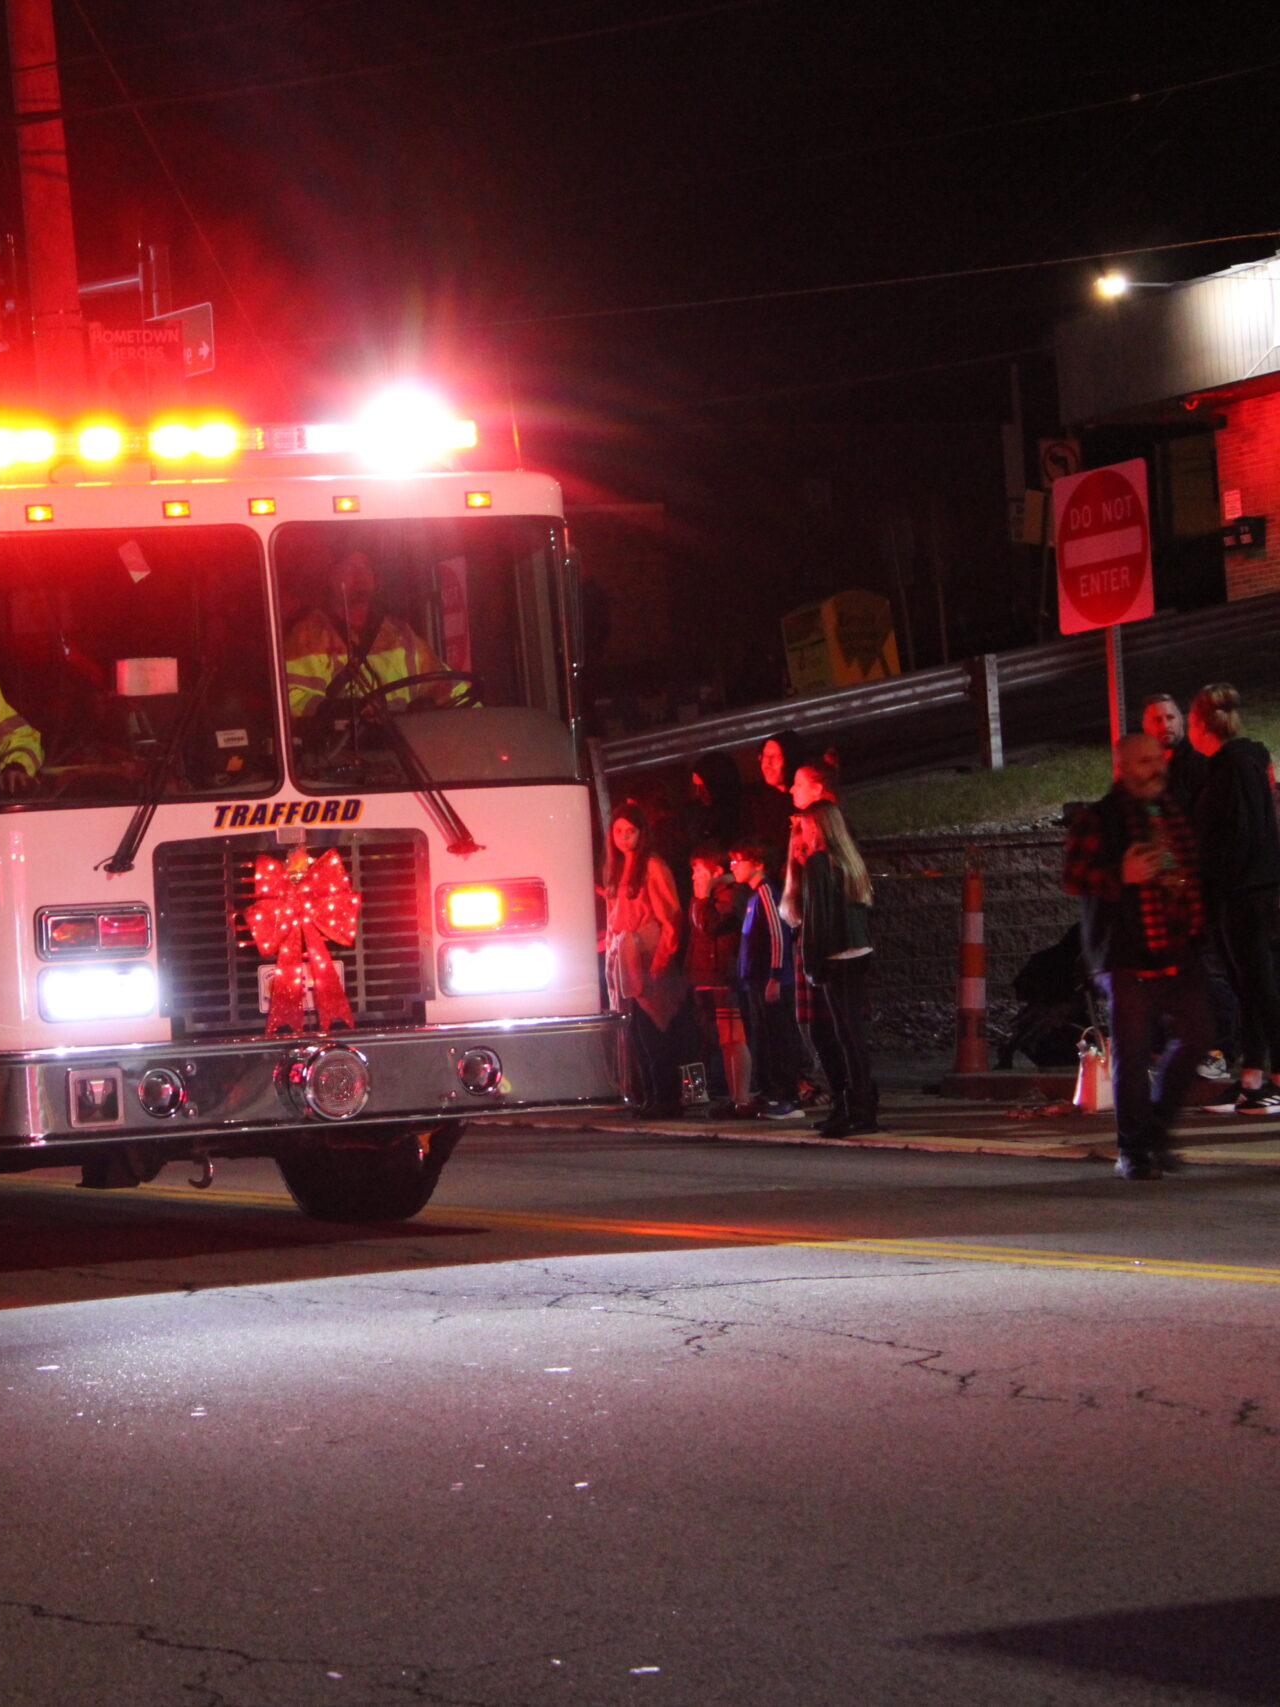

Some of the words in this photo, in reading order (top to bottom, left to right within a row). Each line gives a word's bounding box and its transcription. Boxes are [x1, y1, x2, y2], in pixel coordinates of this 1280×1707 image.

[109, 345, 165, 361] HEROES
[1070, 504, 1092, 531] DO
[1102, 495, 1133, 524] NOT
[1079, 566, 1131, 598] ENTER
[214, 799, 364, 829] TRAFFORD
